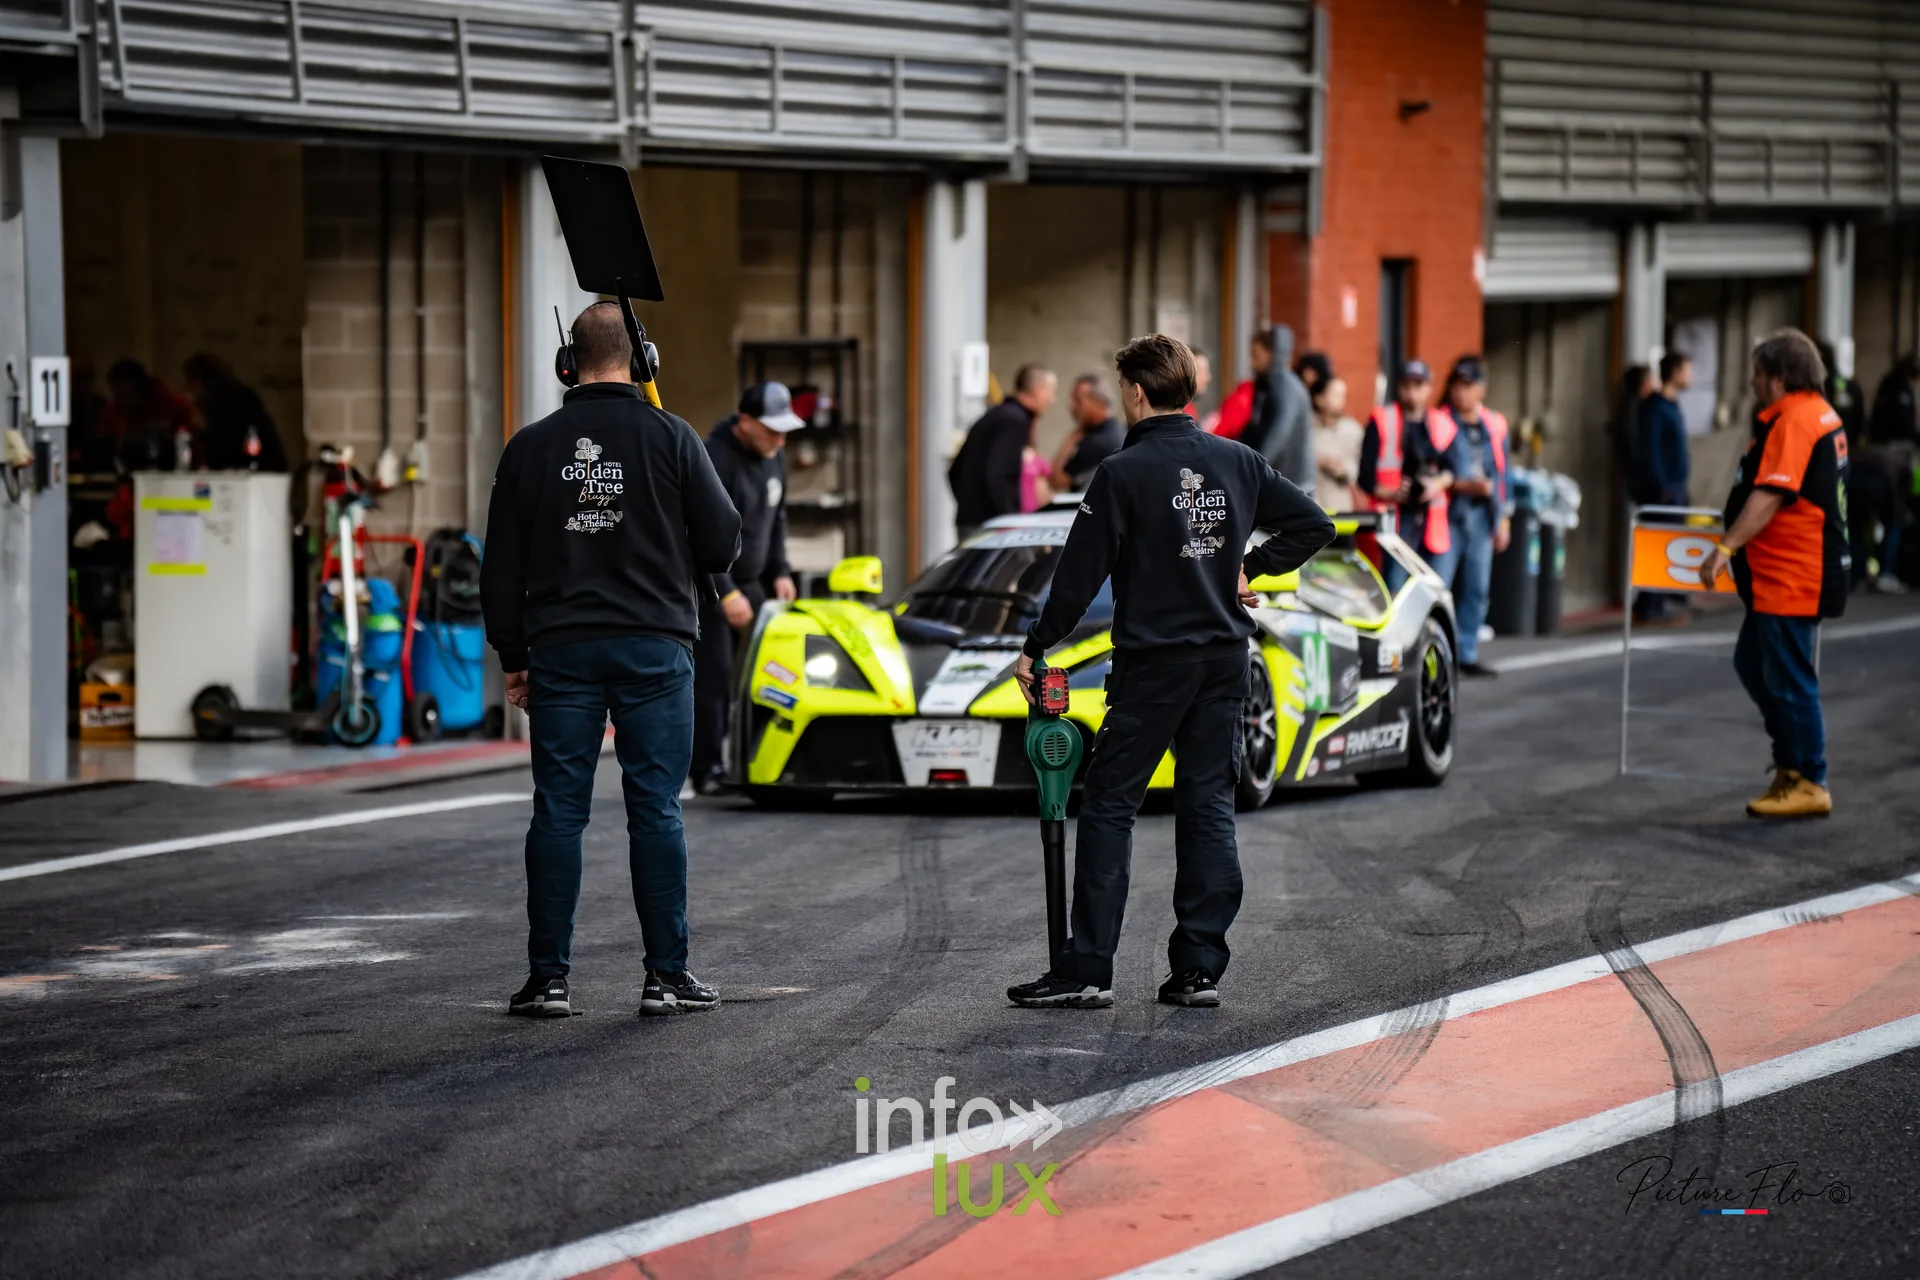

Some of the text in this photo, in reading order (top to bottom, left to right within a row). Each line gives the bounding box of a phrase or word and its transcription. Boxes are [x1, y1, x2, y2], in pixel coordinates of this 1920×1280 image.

[41, 369, 60, 413] 11
[561, 463, 624, 481] Golden
[584, 479, 624, 494] Tree
[578, 486, 617, 507] Brugge
[1172, 492, 1227, 509] Golden
[577, 511, 599, 520] Hotel
[1189, 507, 1226, 522] Tree
[1665, 536, 1733, 585] 9
[1303, 634, 1331, 709] 94
